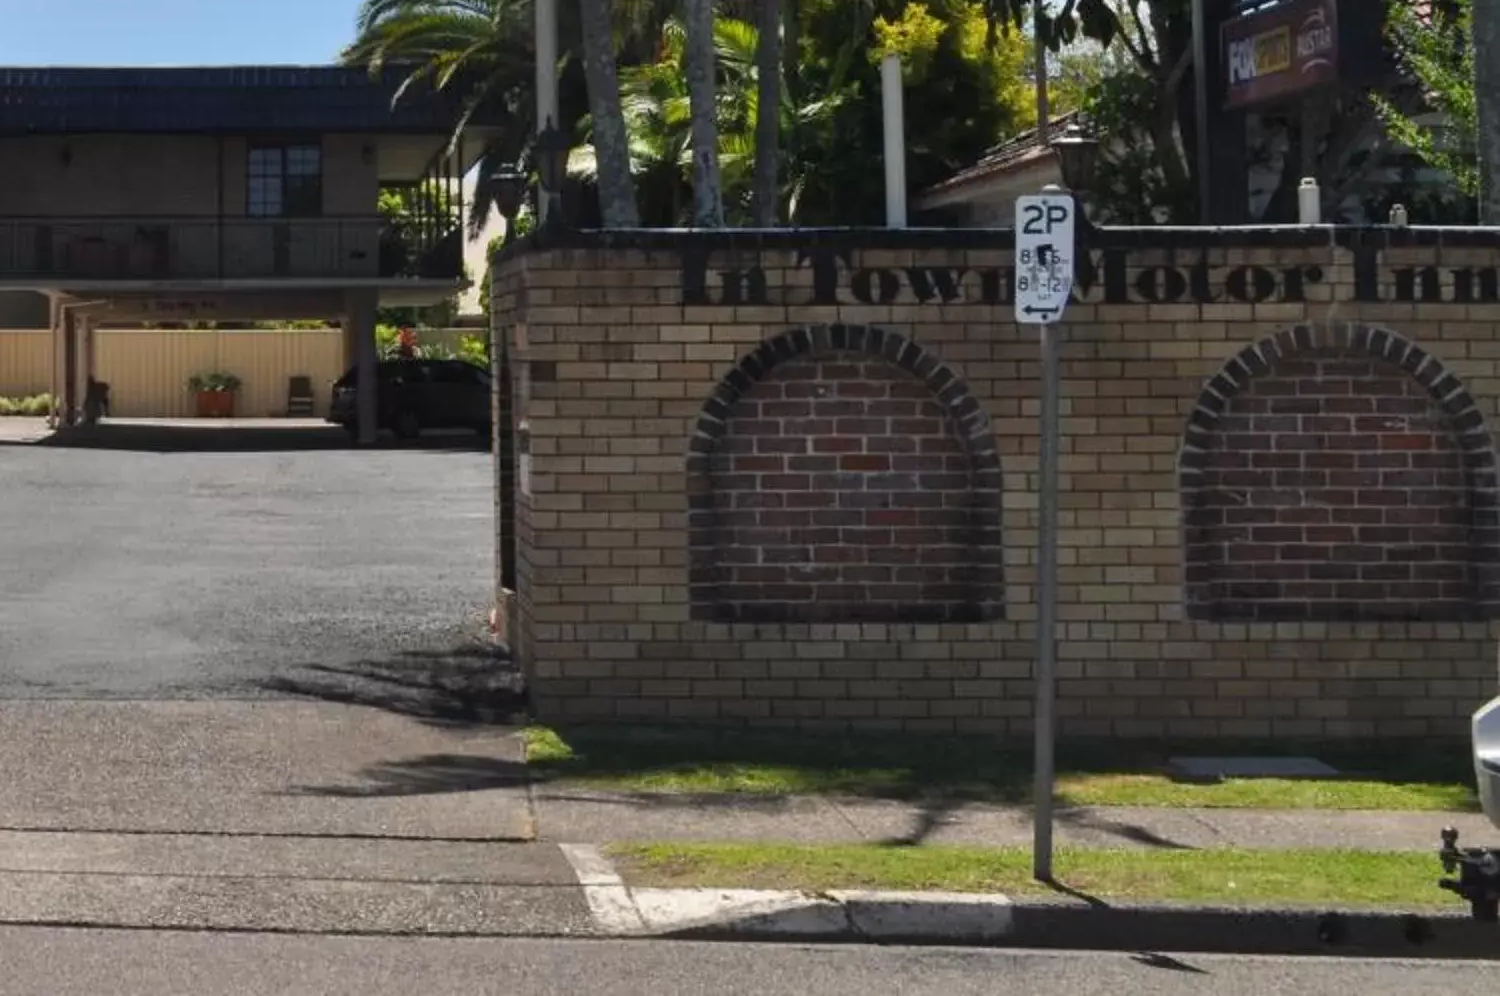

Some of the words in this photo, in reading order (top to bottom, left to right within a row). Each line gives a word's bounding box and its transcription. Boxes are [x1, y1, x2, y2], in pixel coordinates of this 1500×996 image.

[1228, 36, 1257, 85] FOX
[1022, 205, 1068, 234] 2P
[680, 243, 767, 303] In
[1351, 243, 1500, 303] Inn
